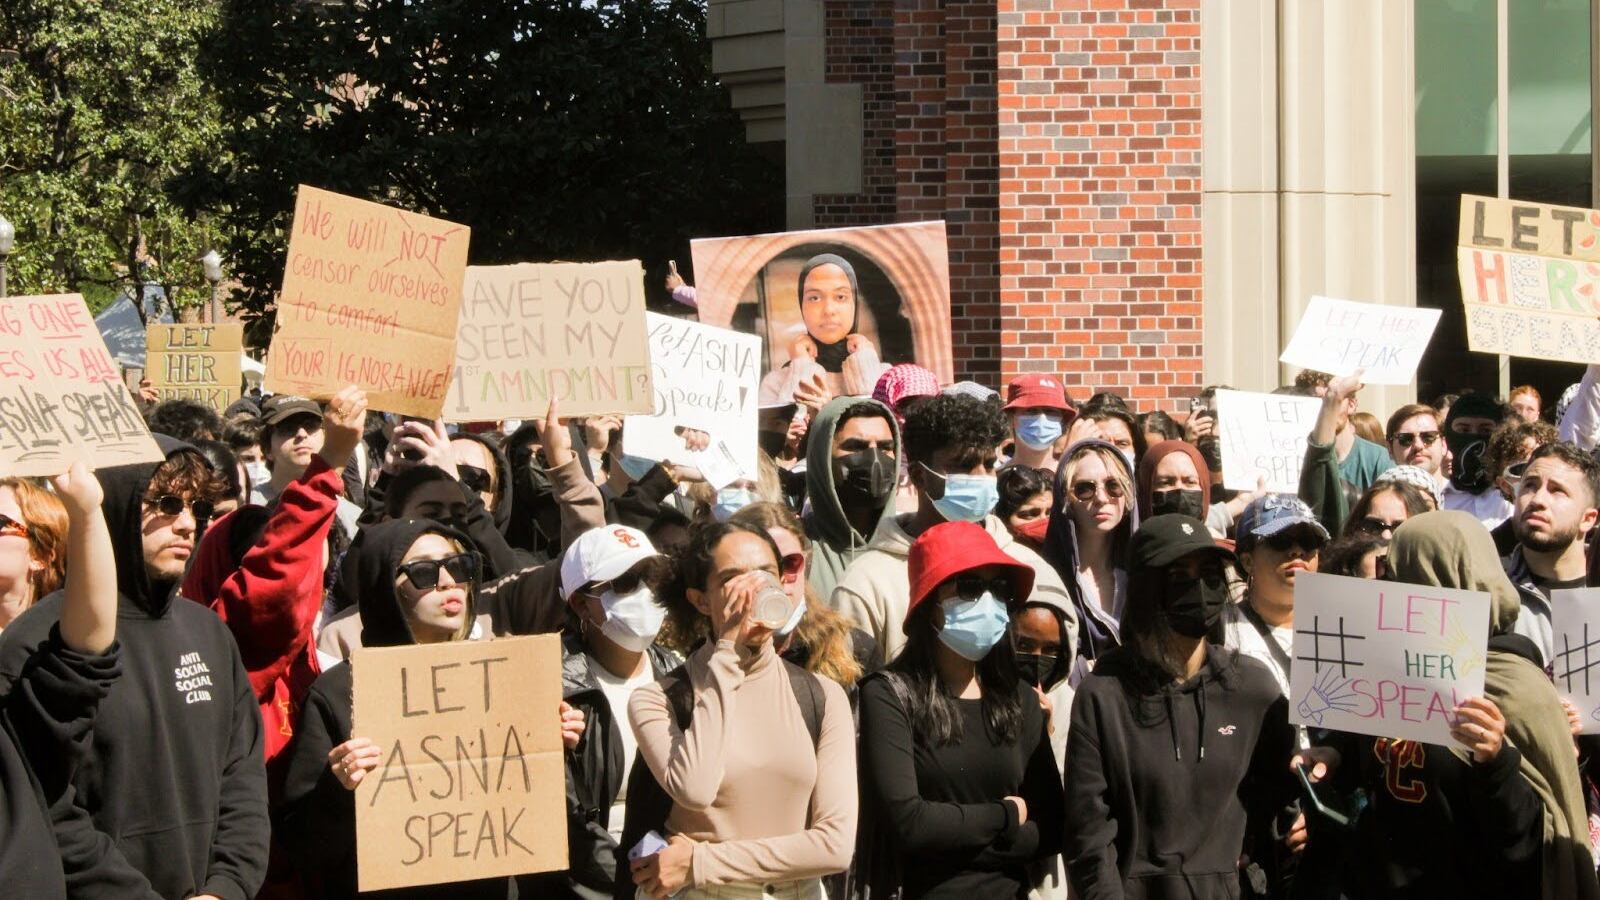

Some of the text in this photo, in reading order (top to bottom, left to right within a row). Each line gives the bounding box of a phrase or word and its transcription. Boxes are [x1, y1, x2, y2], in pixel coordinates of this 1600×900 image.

[302, 201, 447, 264] We will NOT
[1472, 200, 1586, 256] LET
[292, 253, 449, 307] censor ourselves
[555, 277, 633, 319] YOU
[1472, 250, 1587, 312] HER
[29, 302, 88, 333] ONE
[292, 292, 401, 338] to comfort
[1325, 306, 1421, 335] LET HER
[167, 327, 216, 349] LET
[456, 321, 624, 362] SEEN MY
[1319, 337, 1403, 369] SPEAK
[43, 346, 80, 379] US
[165, 354, 218, 384] HER
[283, 341, 452, 400] YOUR IGNORANCE!
[682, 332, 758, 386] ASNA
[63, 378, 152, 443] SPEAK
[1263, 400, 1305, 424] LET
[1376, 591, 1460, 636] LET
[174, 662, 211, 679] SOCIAL
[180, 652, 200, 666] ANTI
[1405, 649, 1456, 680] HER
[175, 675, 213, 692] SOCIAL
[185, 690, 212, 705] CLUB
[400, 656, 509, 718] LET
[369, 724, 532, 808] ASNA
[401, 807, 535, 867] SPEAK
